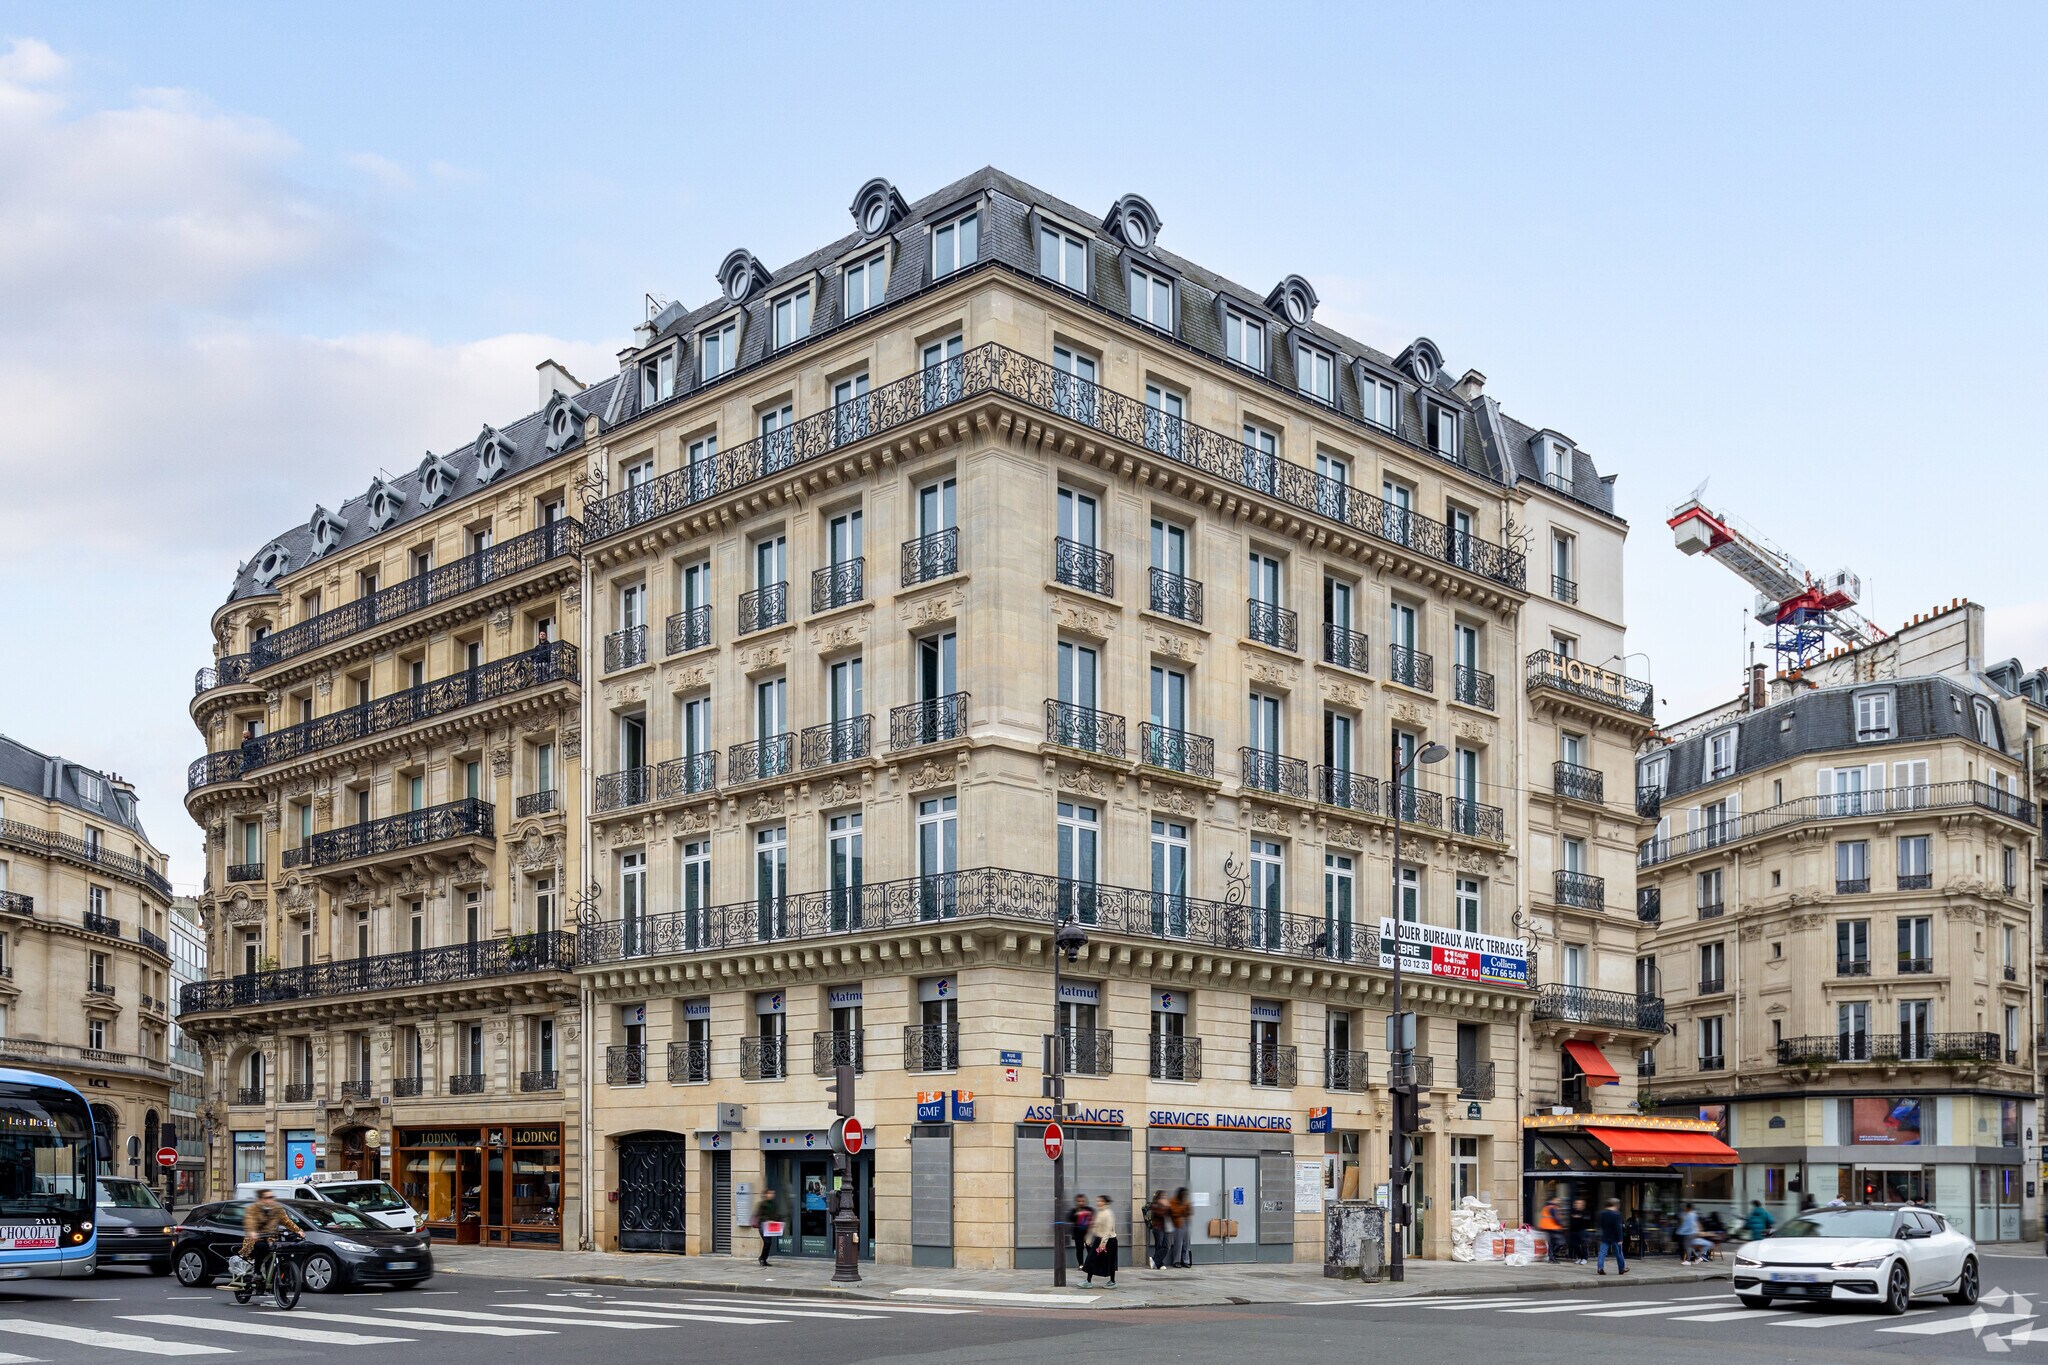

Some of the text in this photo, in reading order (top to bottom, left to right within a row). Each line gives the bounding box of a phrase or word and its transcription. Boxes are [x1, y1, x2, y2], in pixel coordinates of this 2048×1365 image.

[1549, 652, 1633, 700] HOTEL
[1384, 922, 1523, 957] A OUER BUREAUX AVEC TERRASSE
[1454, 951, 1469, 959] Knight
[1382, 955, 1429, 969] 06 03 12 33
[1490, 957, 1517, 969] Colliers
[1434, 963, 1442, 971] 06
[1443, 964, 1451, 973] 08
[1453, 966, 1460, 974] 77
[1462, 967, 1469, 975] 21
[1471, 969, 1478, 977] 10
[1482, 966, 1525, 979] 06 77 66 54 09
[1250, 1005, 1281, 1018] atmut
[88, 1078, 111, 1088] LCL
[919, 1106, 940, 1117] GMF
[959, 1105, 973, 1117] GMF
[1149, 1110, 1292, 1130] SERVICES FINANCIERS
[1310, 1120, 1326, 1130] GMF
[421, 1132, 457, 1144] LODING
[517, 1131, 557, 1143] LODING
[0, 1226, 57, 1239] CHOCOLAT
